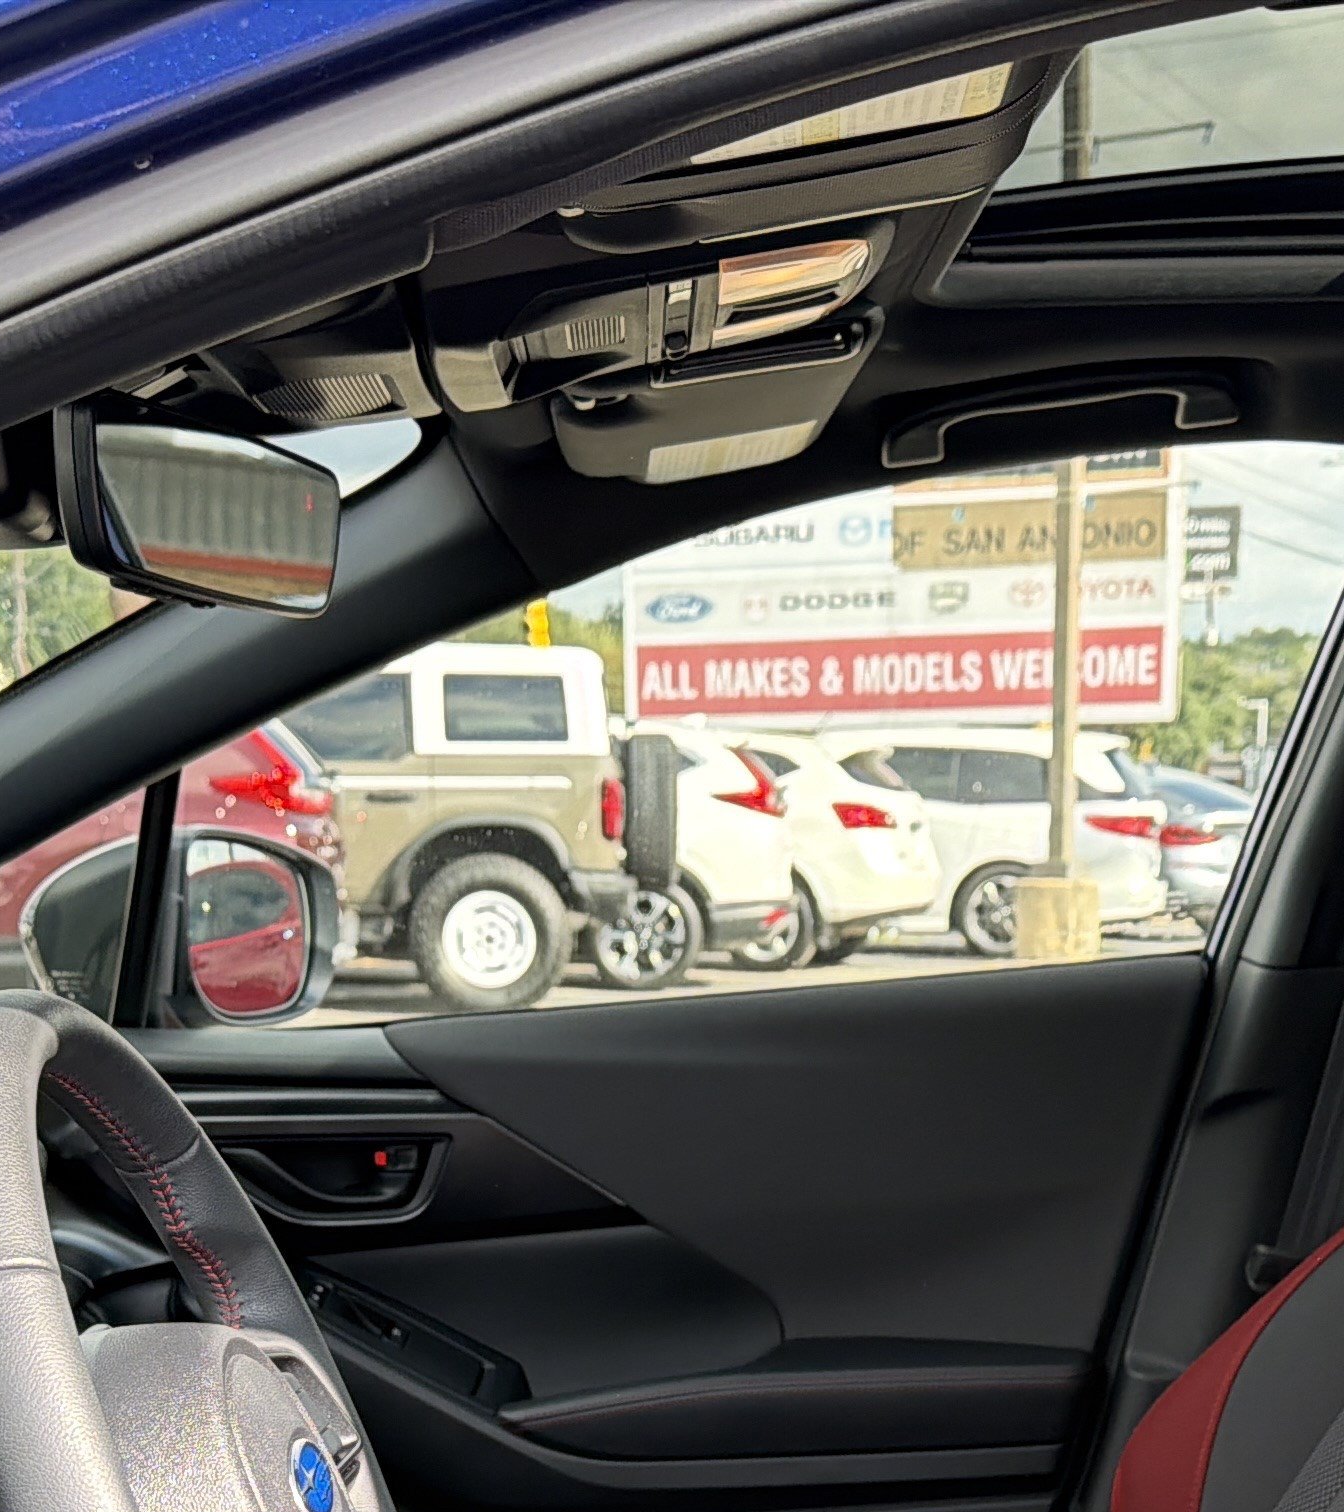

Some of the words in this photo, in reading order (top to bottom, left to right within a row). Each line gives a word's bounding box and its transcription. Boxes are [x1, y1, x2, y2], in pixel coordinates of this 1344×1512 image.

[943, 524, 1005, 555] SAN
[1017, 517, 1157, 551] ANONIO
[778, 590, 896, 611] DODGE
[641, 659, 699, 701] ALL
[705, 655, 811, 699] MAKES
[818, 654, 844, 696] &
[853, 649, 984, 695] MODELS
[989, 643, 1158, 691] WELOME
